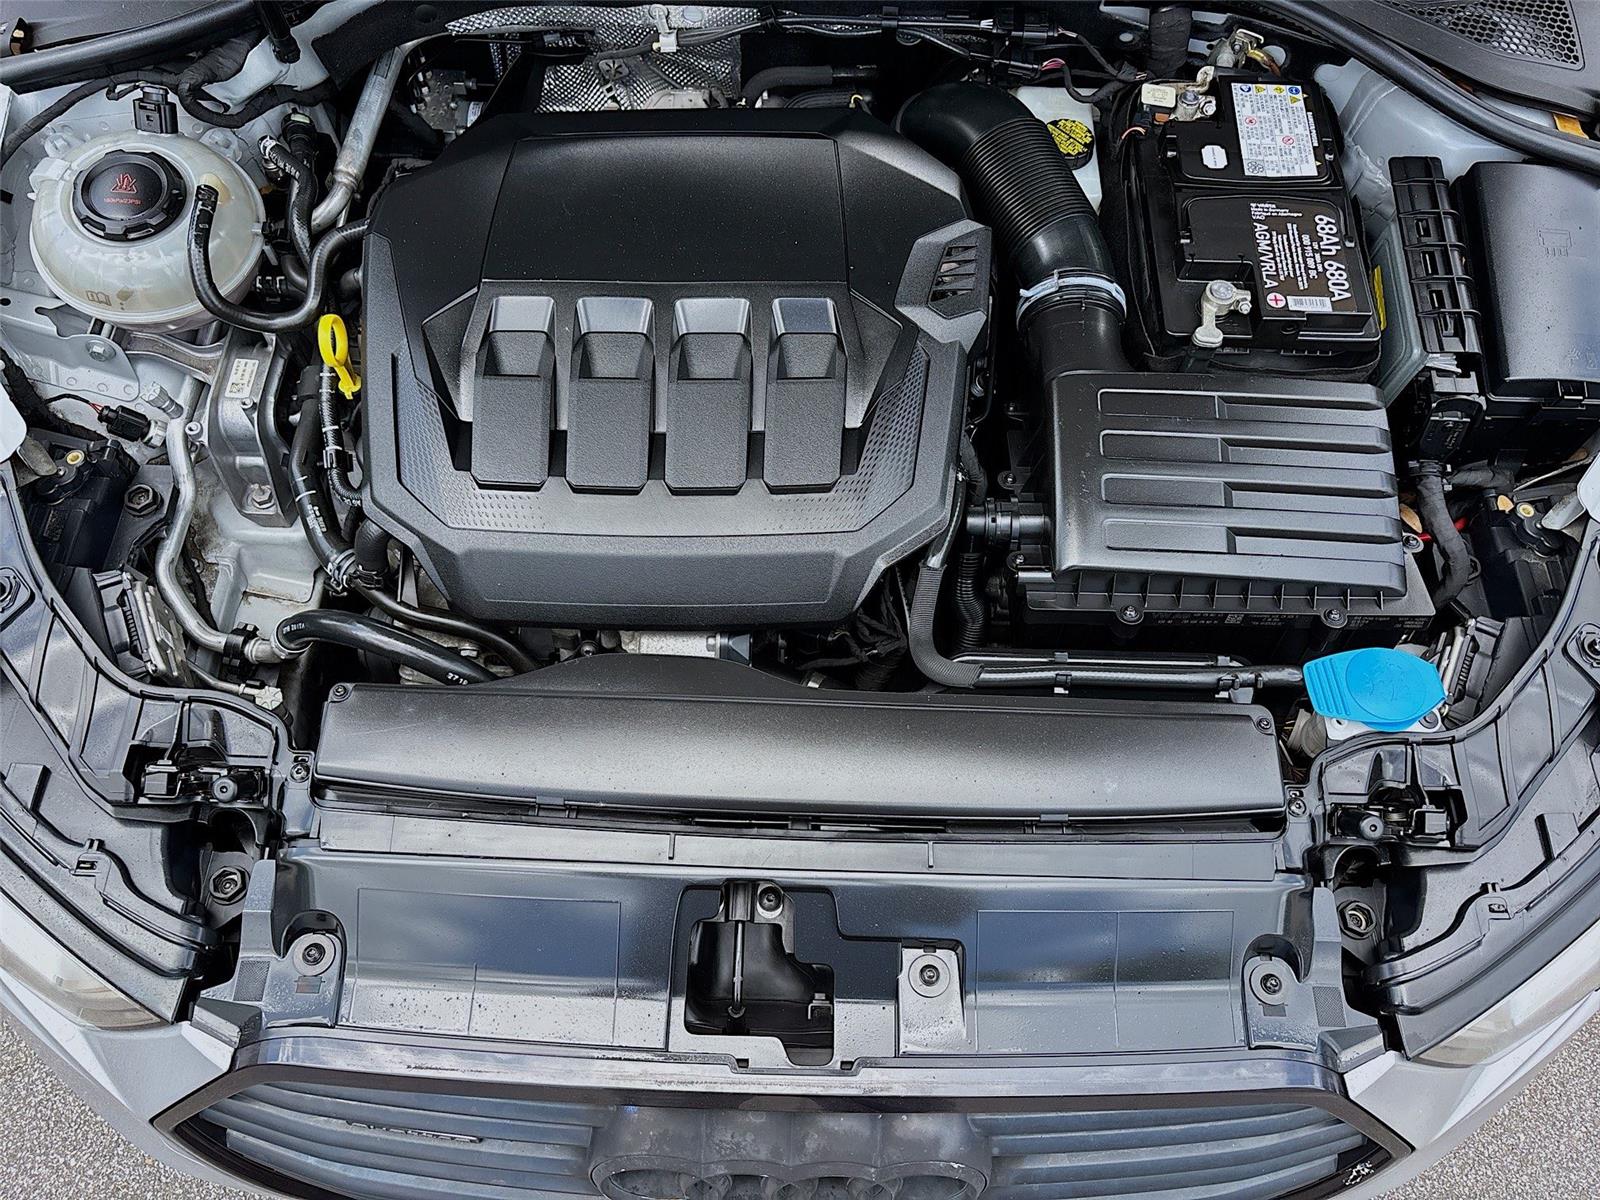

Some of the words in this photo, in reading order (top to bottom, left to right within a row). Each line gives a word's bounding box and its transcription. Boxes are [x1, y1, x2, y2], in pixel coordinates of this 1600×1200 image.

[1253, 222, 1279, 288] AGM/VRLA
[1314, 214, 1341, 255] 68Ah
[1303, 246, 1313, 257] 915
[1308, 270, 1318, 279] BC
[1323, 260, 1351, 301] 680A
